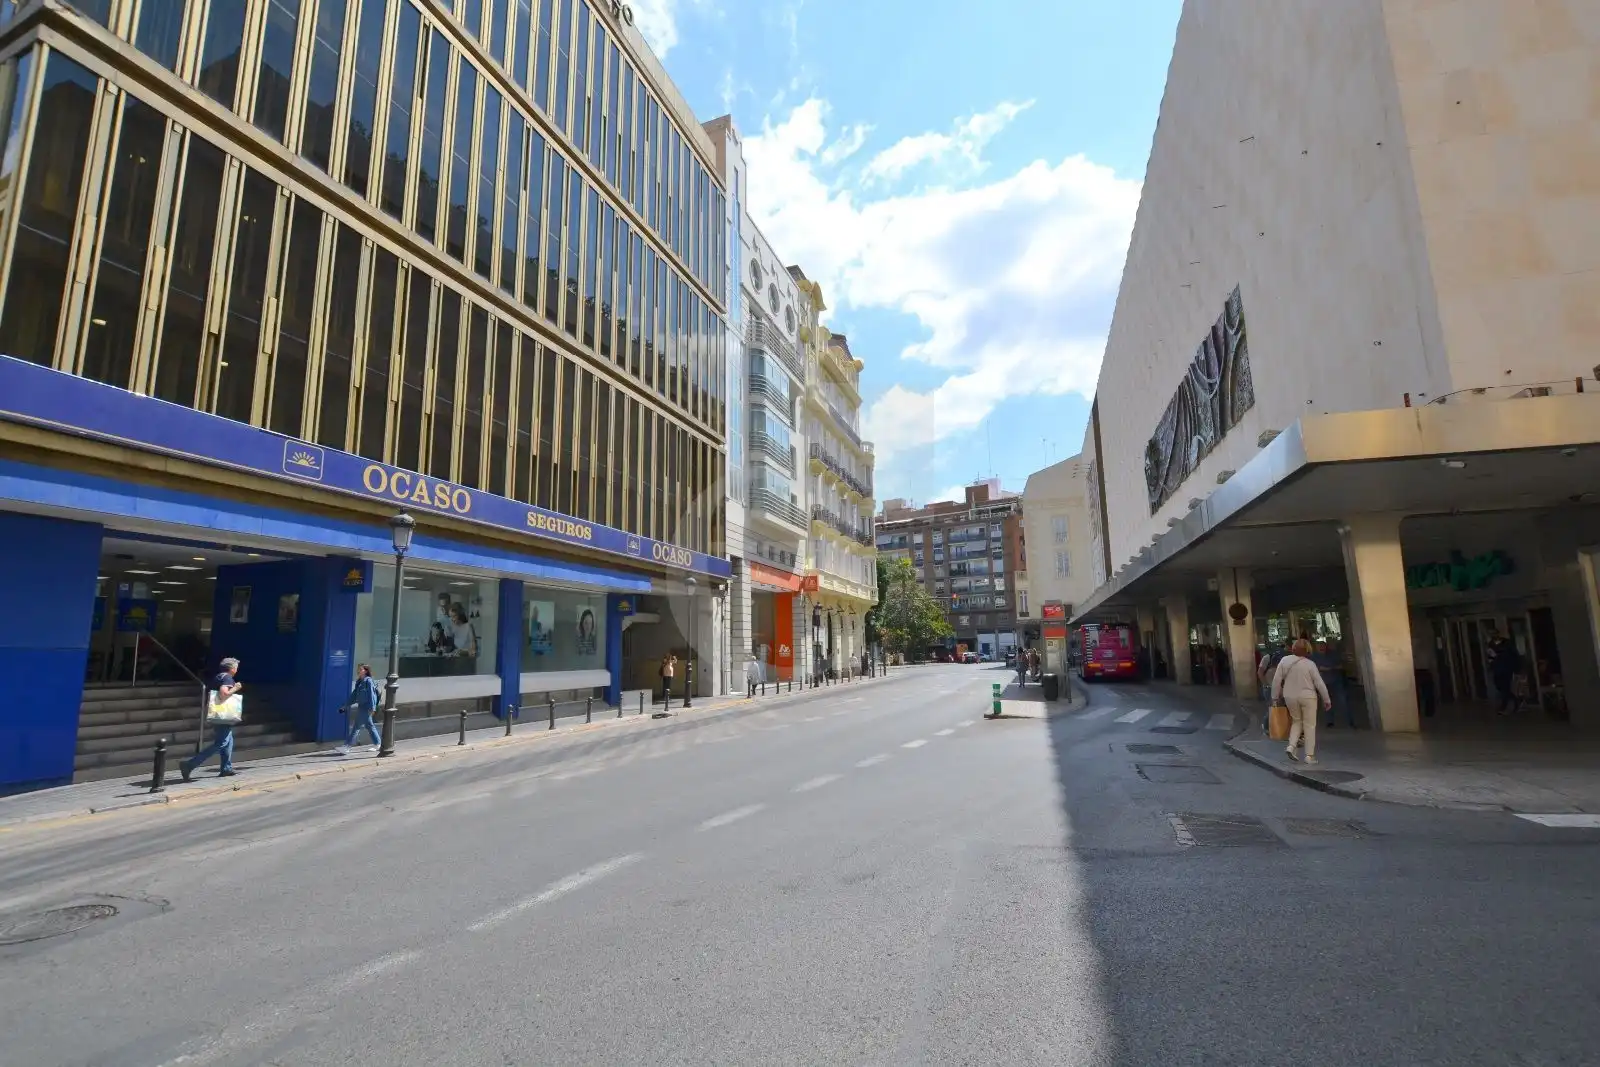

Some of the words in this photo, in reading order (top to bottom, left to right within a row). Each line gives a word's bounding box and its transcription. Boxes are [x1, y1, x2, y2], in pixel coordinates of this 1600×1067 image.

[363, 465, 471, 513] OCASO
[527, 511, 592, 541] SEGUROS
[652, 543, 692, 567] OCASO
